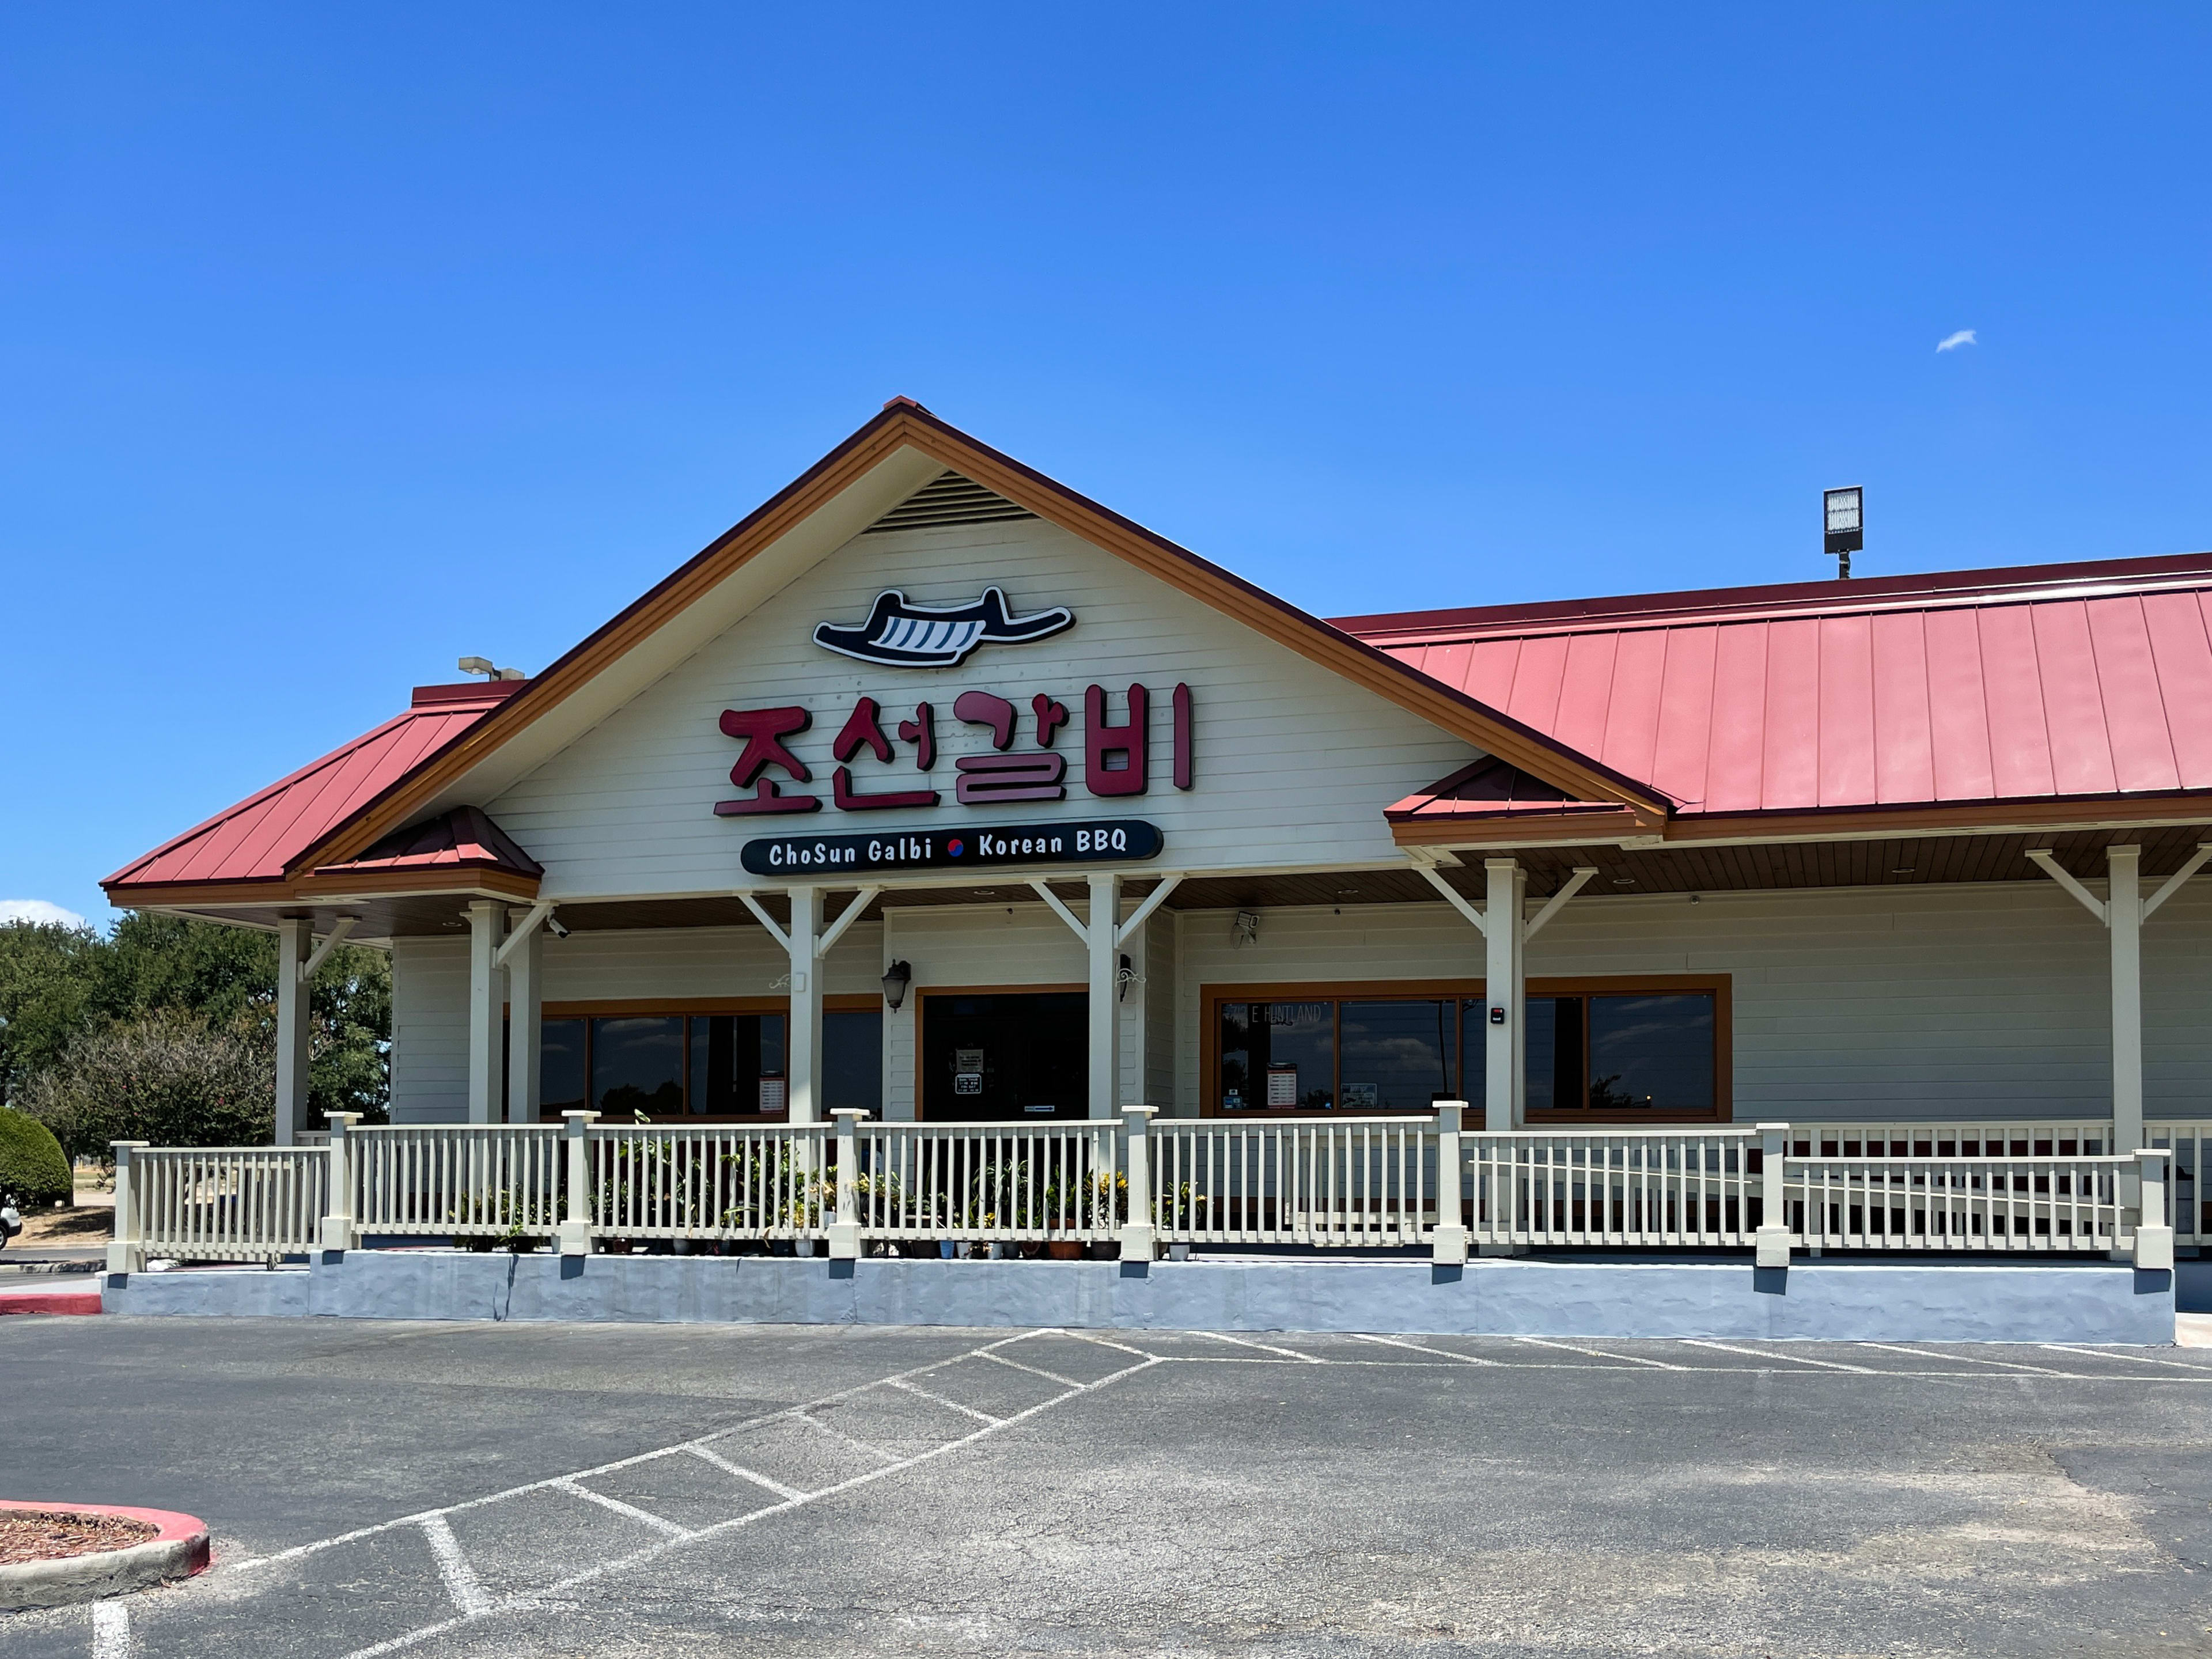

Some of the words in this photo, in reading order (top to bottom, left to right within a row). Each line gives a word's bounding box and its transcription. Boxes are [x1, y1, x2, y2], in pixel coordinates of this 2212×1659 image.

[714, 683, 1195, 817] 조선갈비
[769, 844, 855, 866] ChoSun
[868, 838, 932, 862] Galbi
[979, 834, 1063, 856] Korean
[1076, 828, 1127, 852] BBQ
[1252, 1006, 1259, 1022] E
[1264, 1004, 1321, 1022] HUNTLAND
